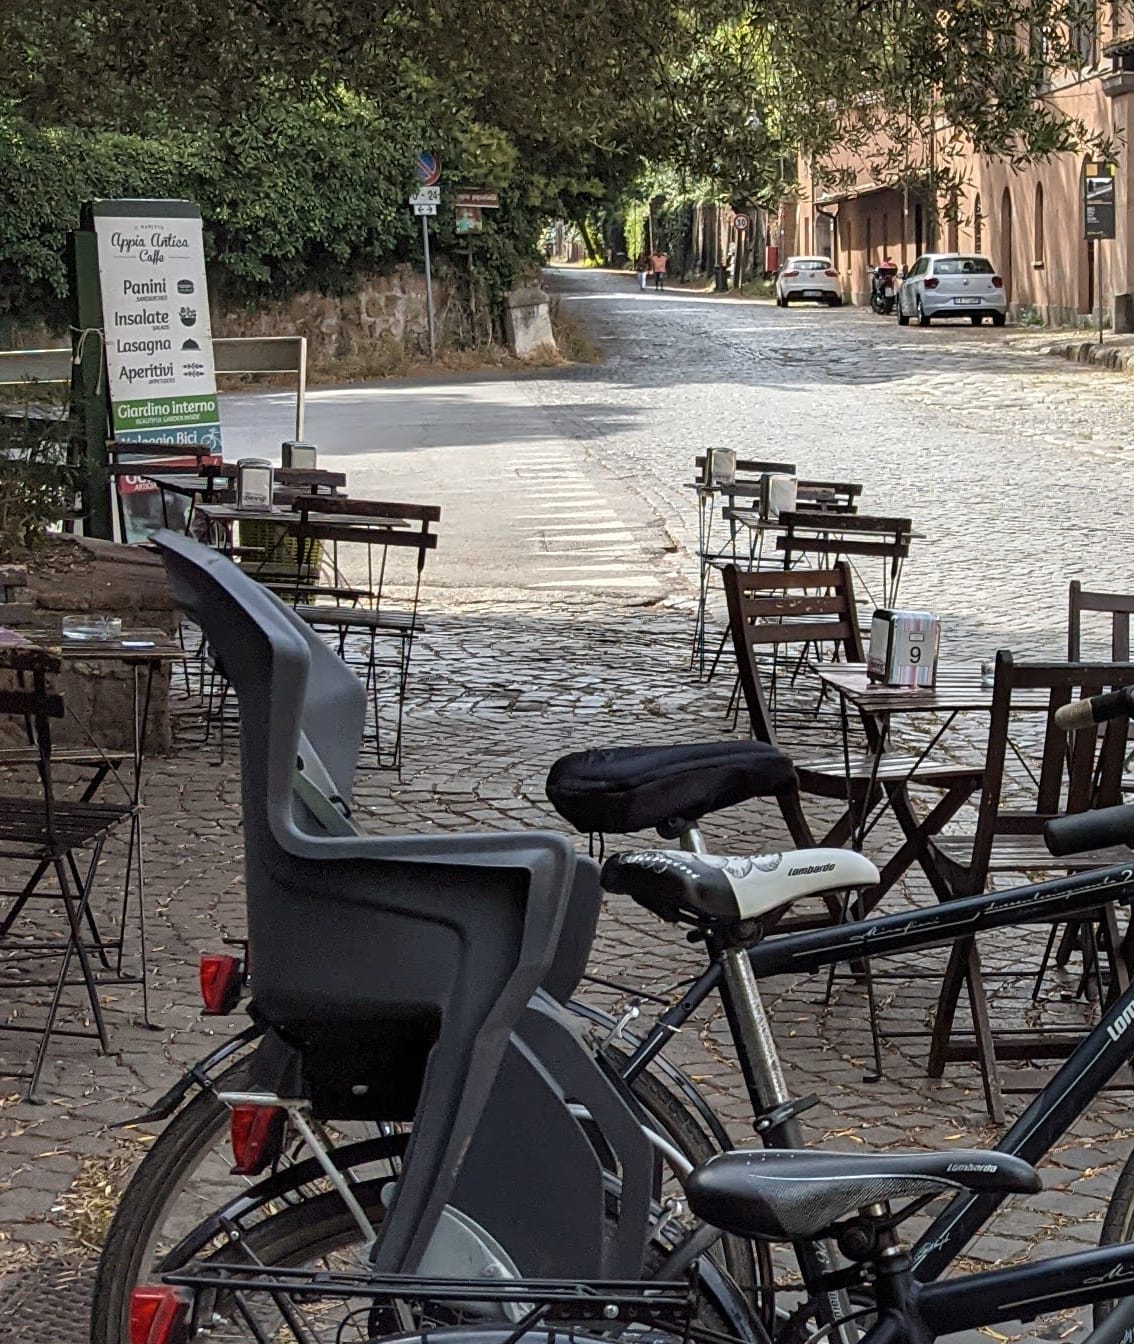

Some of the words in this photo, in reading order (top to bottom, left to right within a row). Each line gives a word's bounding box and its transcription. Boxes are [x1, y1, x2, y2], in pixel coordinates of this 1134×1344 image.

[111, 232, 146, 253] Appia
[150, 232, 190, 248] Antica
[123, 278, 167, 295] Panini
[115, 308, 169, 326] Insalate
[117, 339, 171, 356] Lasagna
[119, 362, 174, 384] Aperitivi
[118, 401, 170, 419] Giardino
[172, 400, 215, 413] interno
[176, 431, 197, 445] Bici
[910, 646, 921, 664] 9
[788, 862, 836, 877] Lombardo
[946, 1162, 998, 1174] Lombardo
